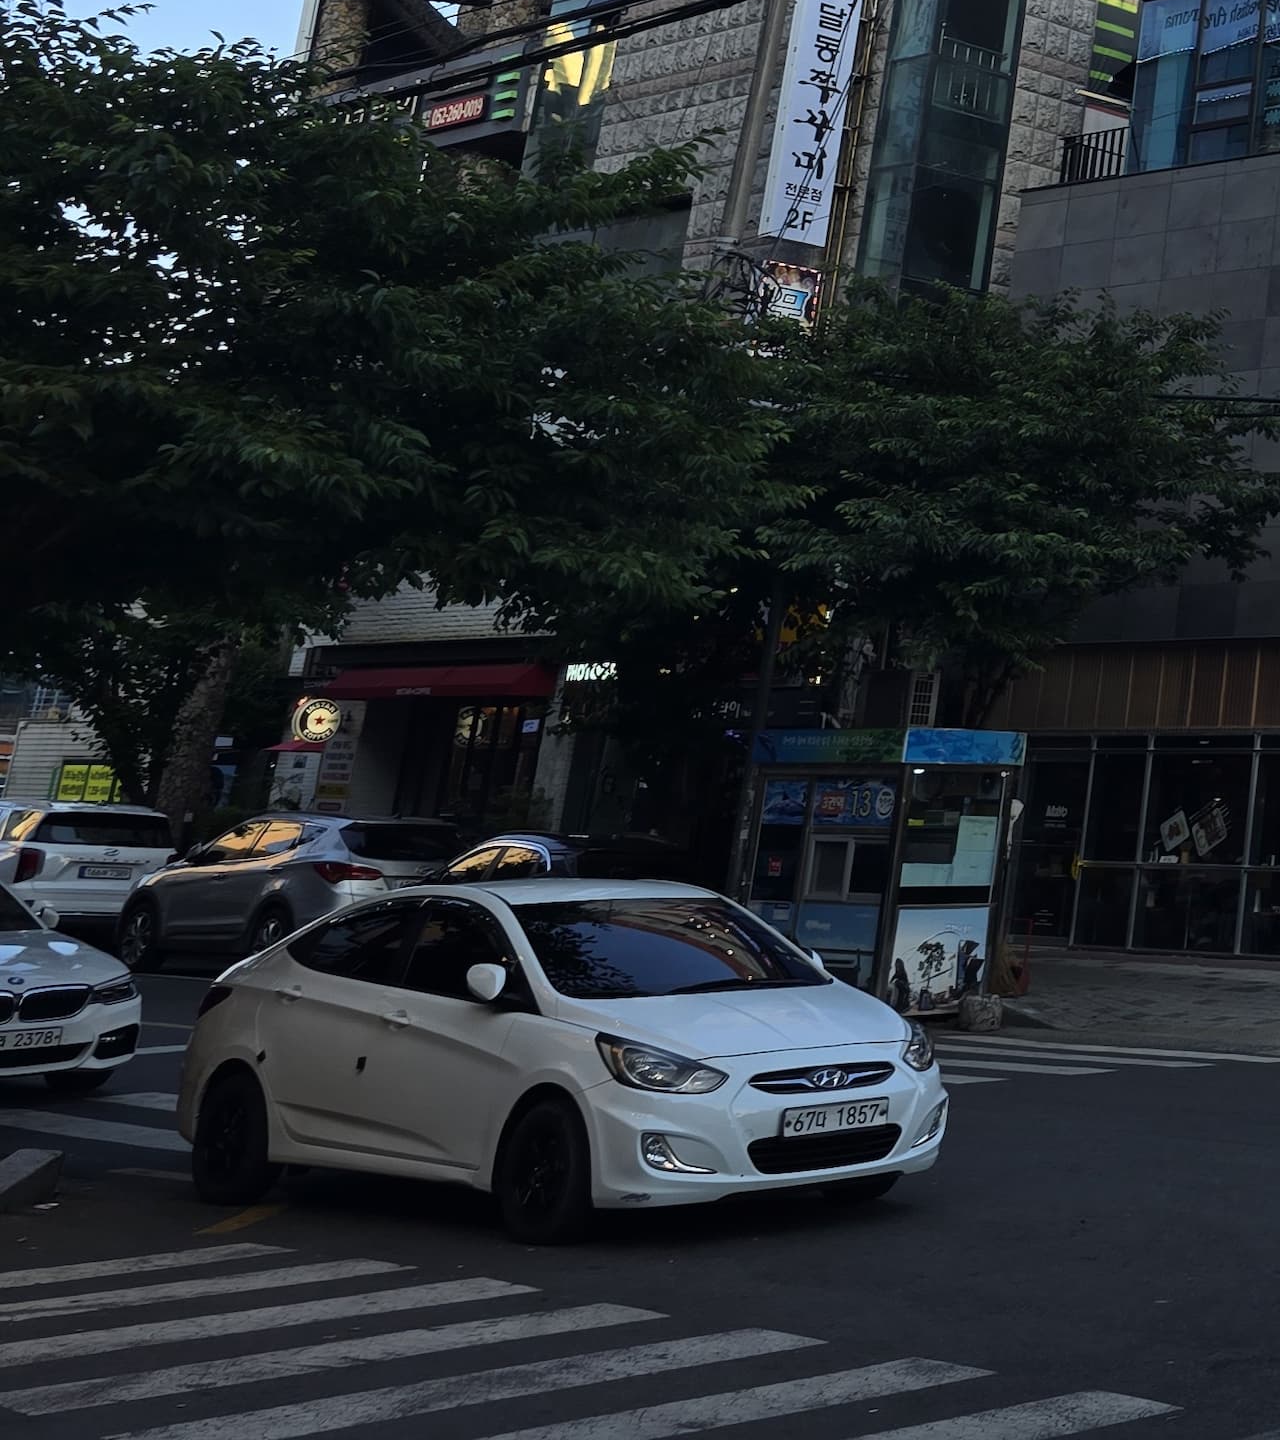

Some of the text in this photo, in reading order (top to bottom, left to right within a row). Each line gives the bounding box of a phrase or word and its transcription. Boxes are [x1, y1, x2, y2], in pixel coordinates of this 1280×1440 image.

[431, 96, 485, 127] 052-260-0019
[784, 182, 823, 202] 전문점
[786, 209, 814, 234] 2F
[851, 787, 872, 817] 13
[14, 1030, 54, 1047] 2378
[836, 1103, 881, 1130] 1857
